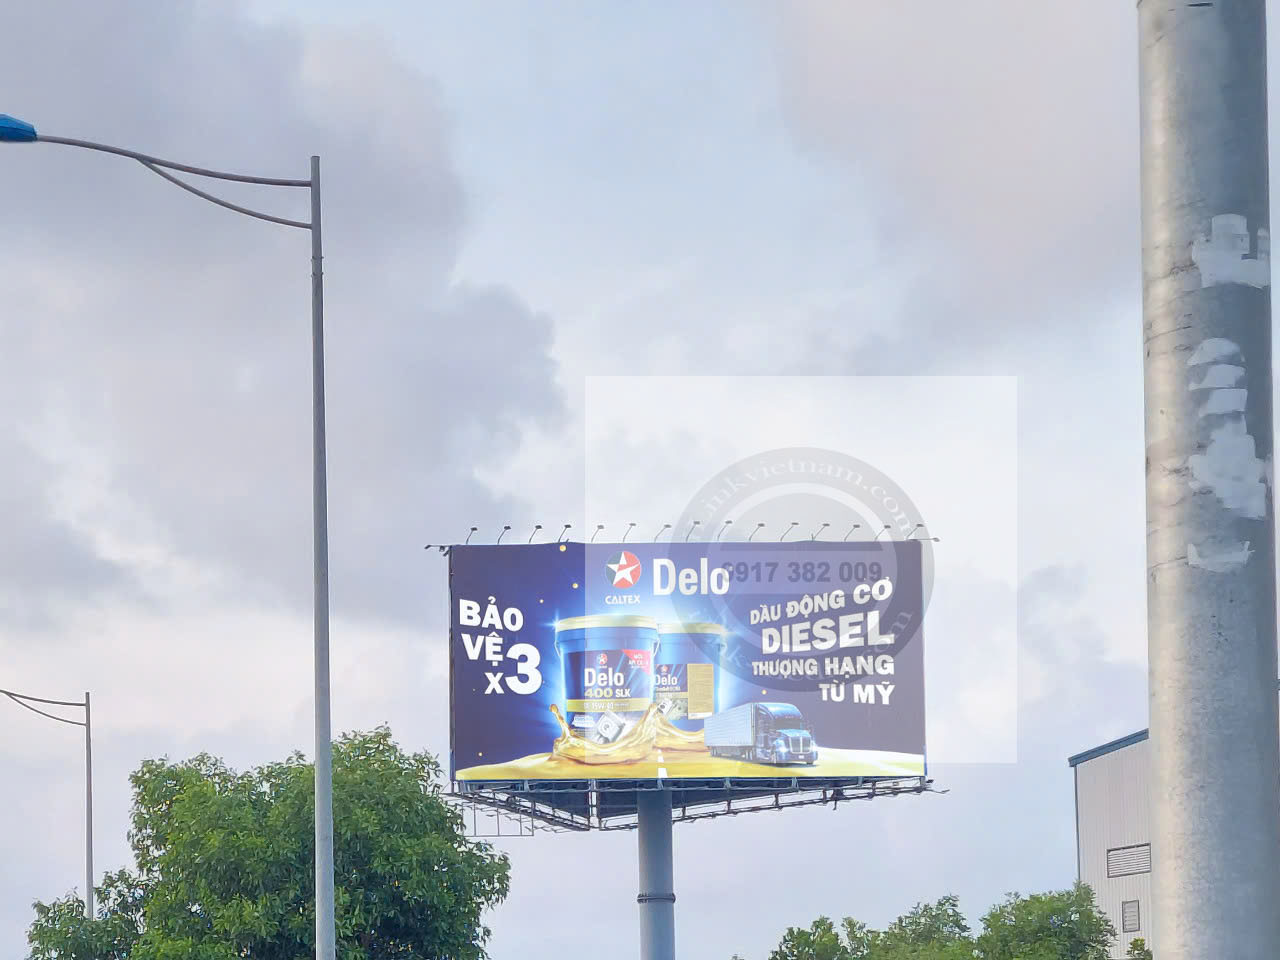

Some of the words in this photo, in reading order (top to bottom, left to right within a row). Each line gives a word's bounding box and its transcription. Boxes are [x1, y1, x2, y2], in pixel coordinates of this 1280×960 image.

[653, 558, 730, 596] Delo
[459, 596, 524, 632] BẢO
[605, 595, 640, 604] CALTEX
[750, 603, 781, 625] DẦU
[786, 590, 845, 618] ĐỘNG
[762, 610, 895, 655] DIESEL
[461, 631, 504, 667] VỆ
[584, 667, 625, 687] Delo
[752, 658, 818, 678] THƯỢNG
[824, 654, 895, 679] HẠNG
[584, 688, 614, 698] 400
[615, 688, 631, 698] SLK
[853, 681, 895, 706] MỸ
